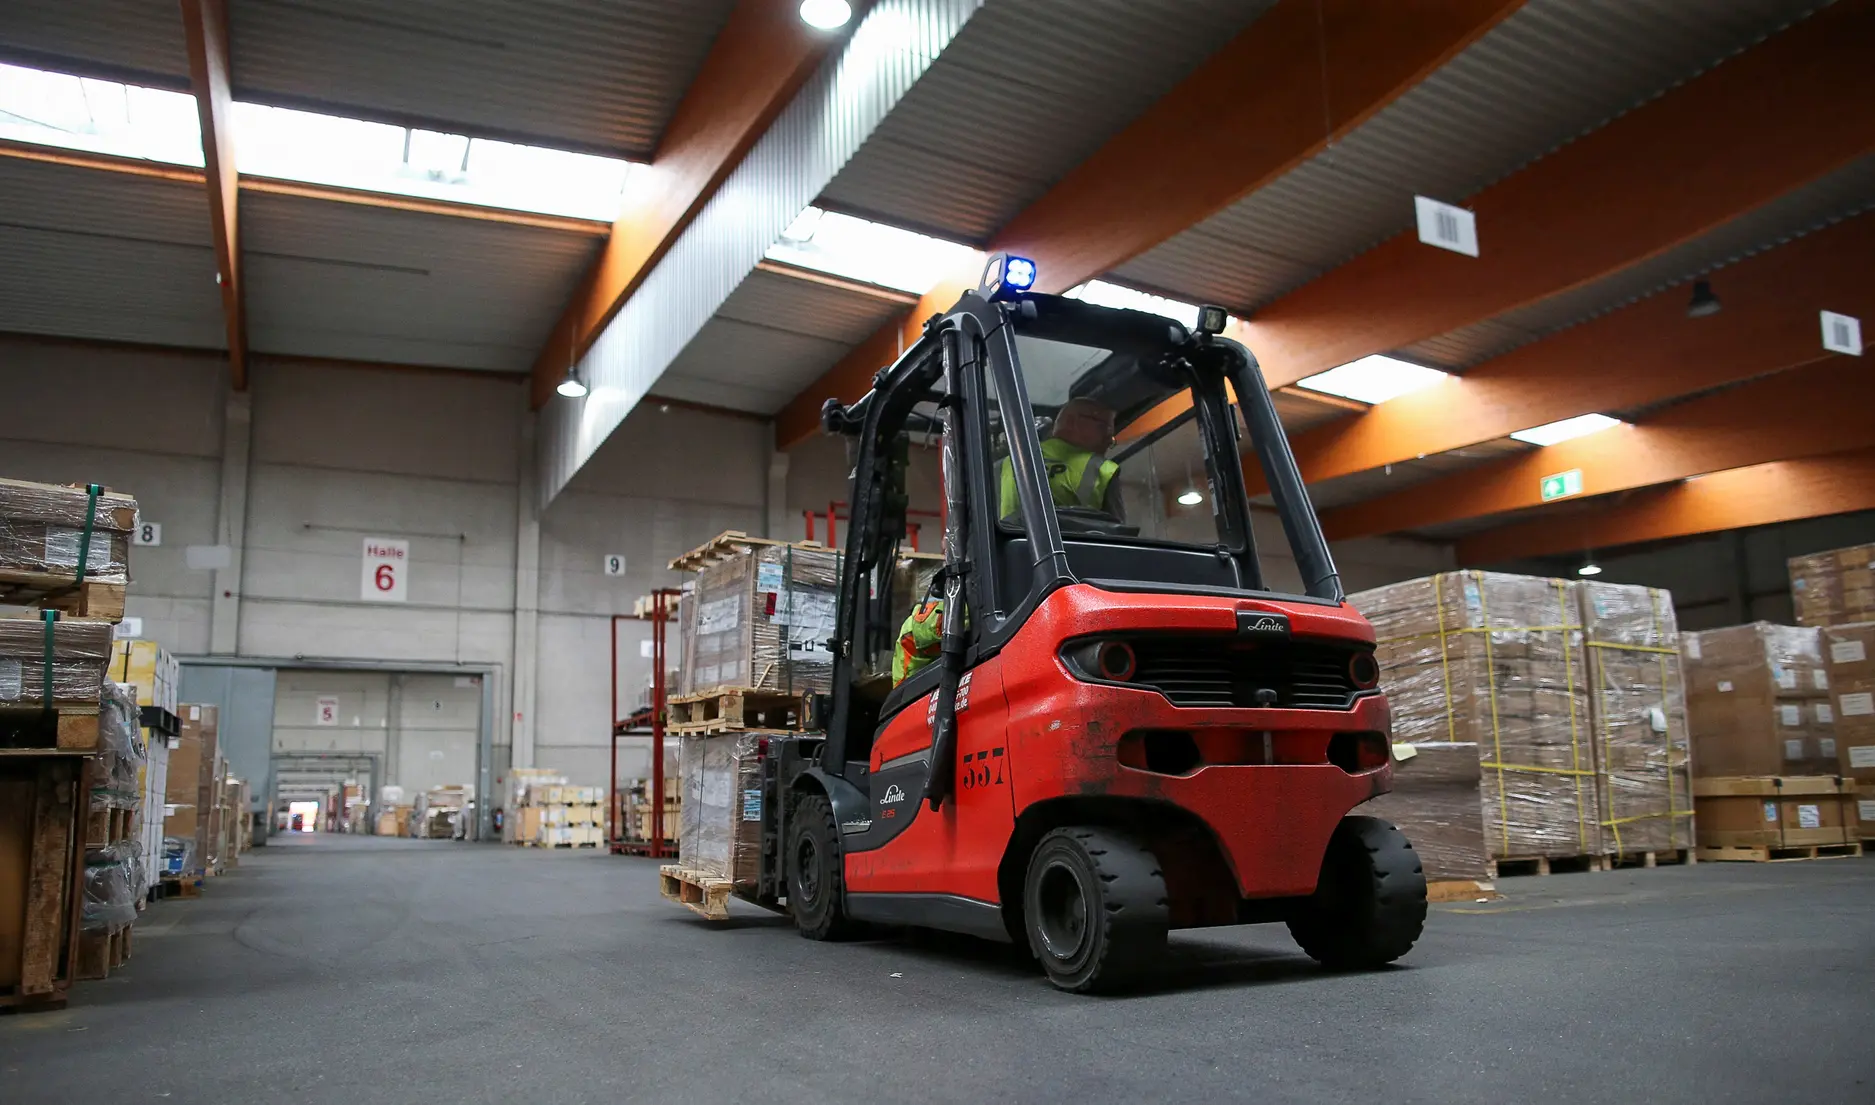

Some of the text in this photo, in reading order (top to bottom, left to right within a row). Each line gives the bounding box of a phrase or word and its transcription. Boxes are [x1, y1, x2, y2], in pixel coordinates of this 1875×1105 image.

[142, 525, 153, 542] 8
[367, 545, 404, 559] Halle
[610, 556, 619, 574] 9
[375, 564, 394, 591] 6
[1247, 616, 1284, 631] Linde
[880, 784, 905, 804] Linde
